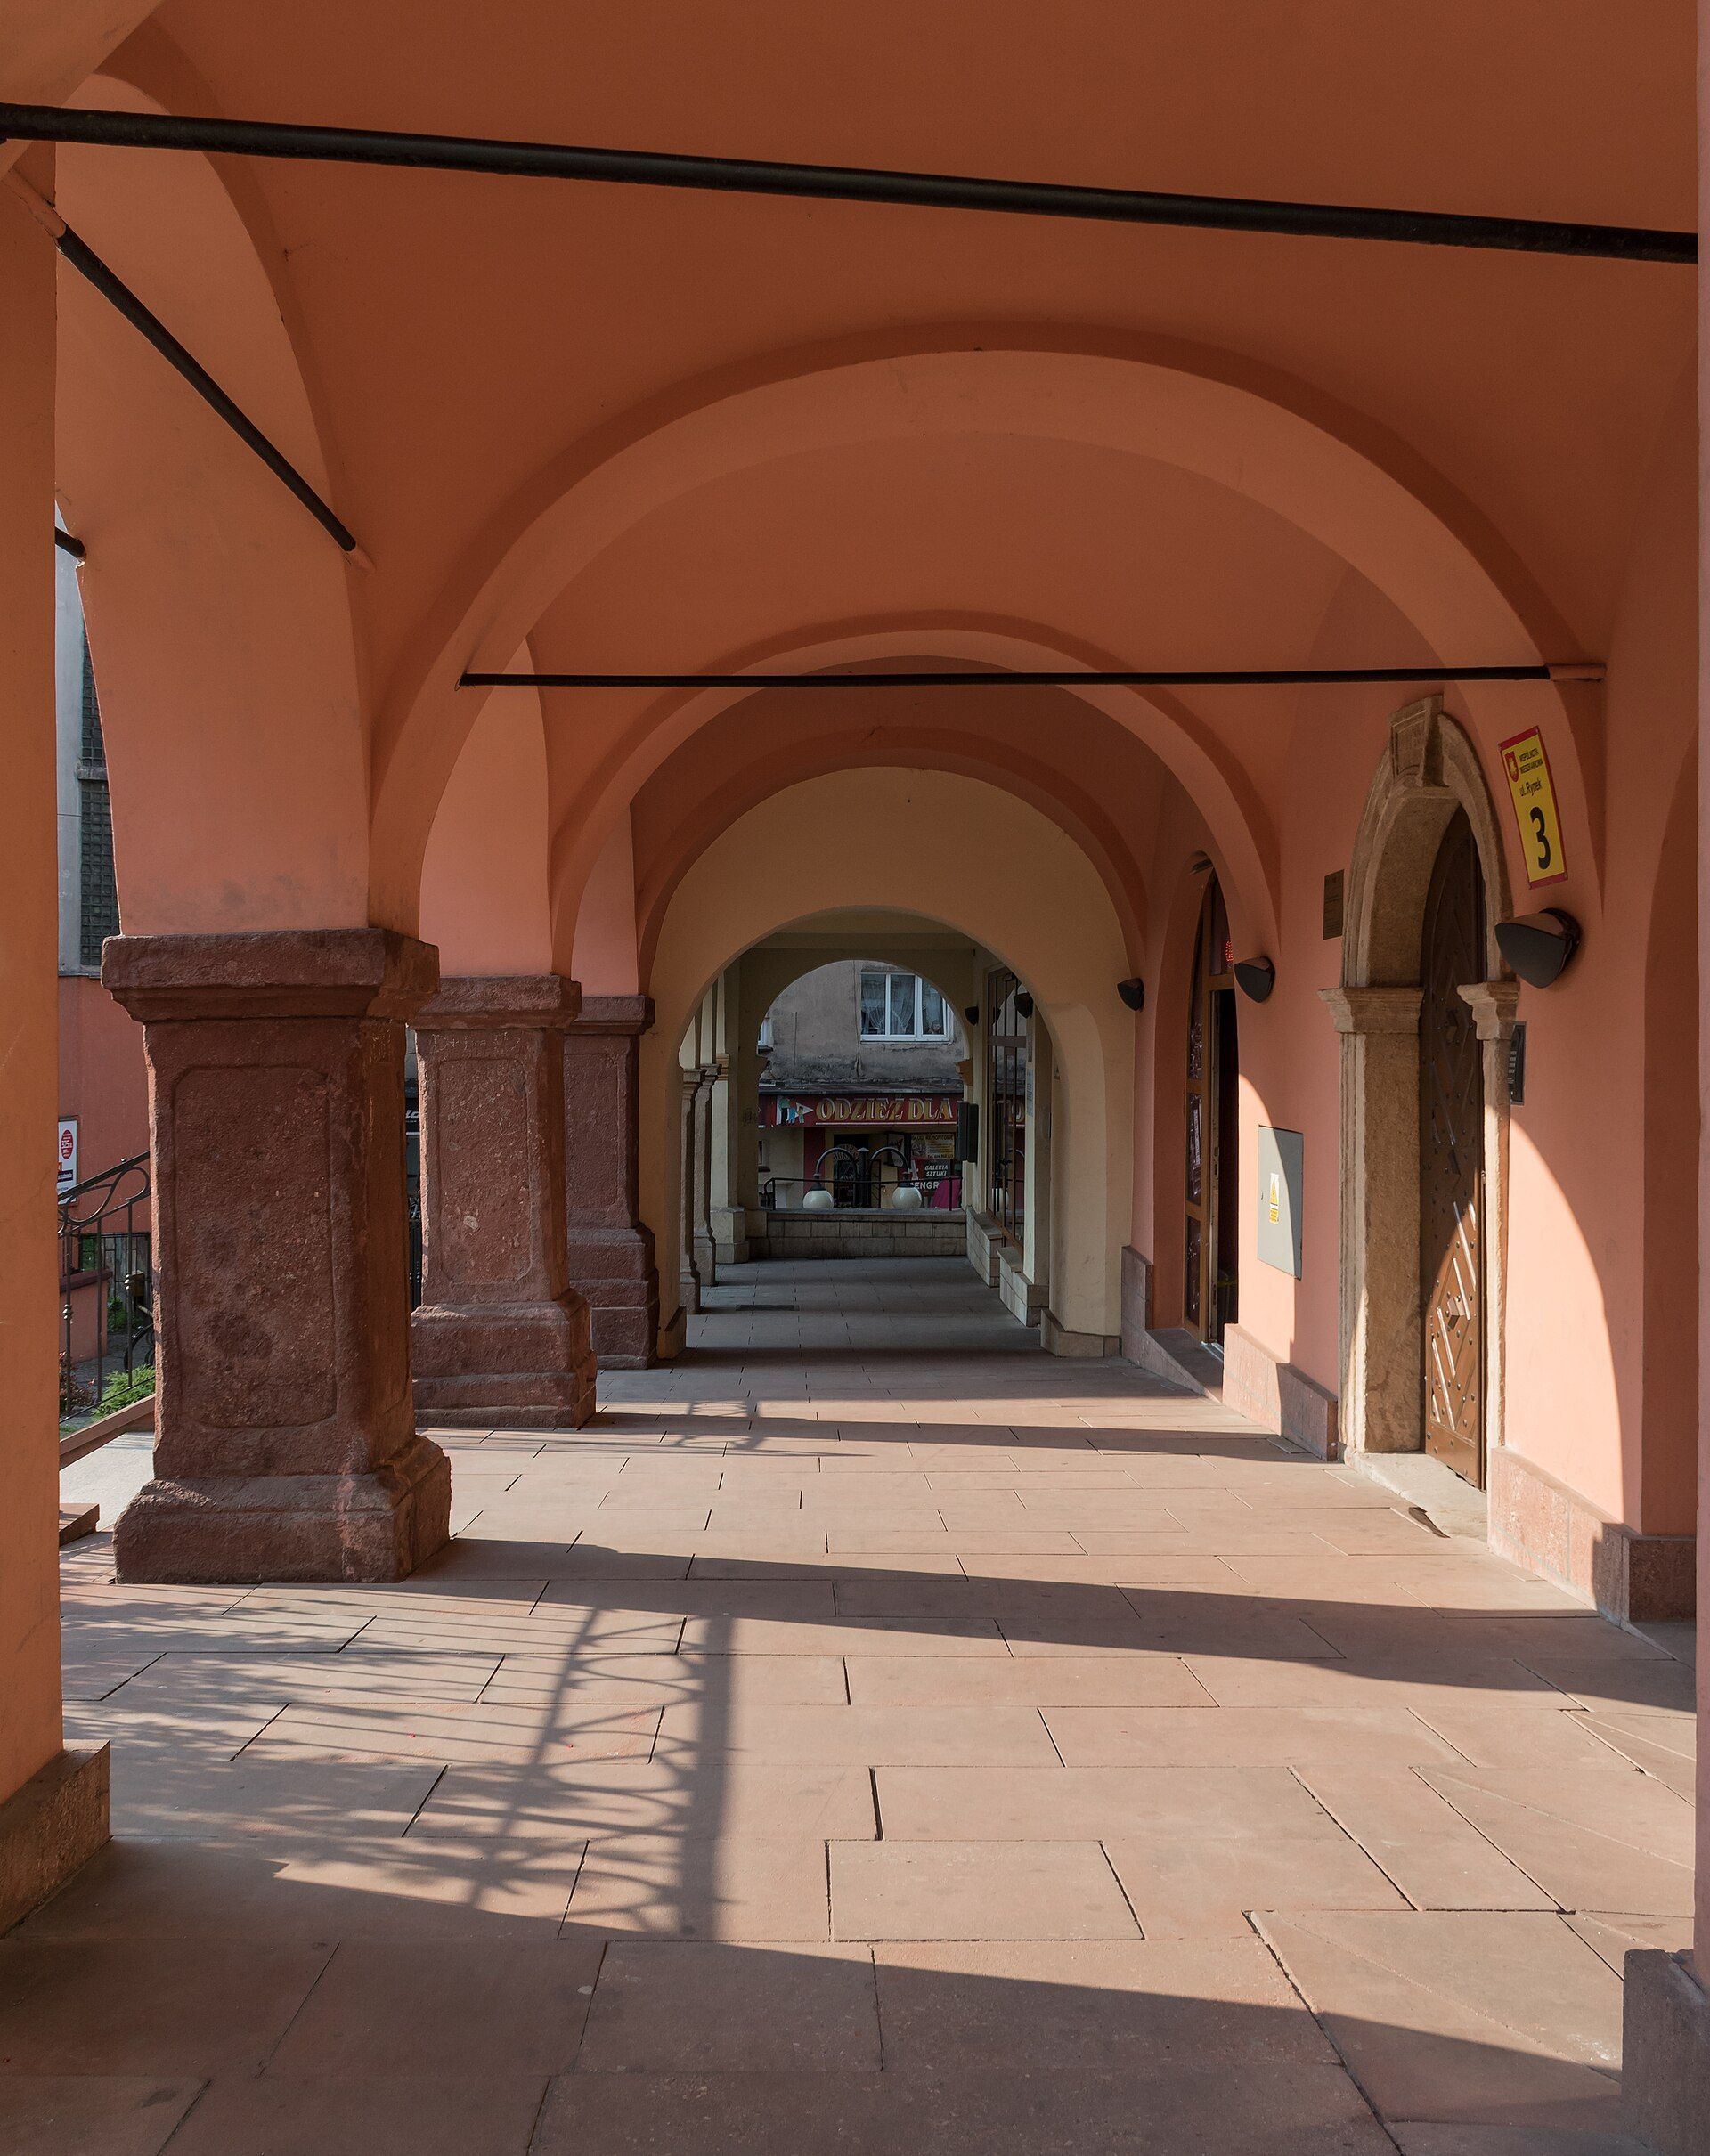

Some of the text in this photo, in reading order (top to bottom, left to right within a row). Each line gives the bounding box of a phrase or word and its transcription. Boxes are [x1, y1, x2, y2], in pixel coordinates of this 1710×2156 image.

[1526, 778, 1542, 796] Rynek
[1529, 806, 1551, 870] 3
[816, 1094, 953, 1121] ODZIEŻ DLA
